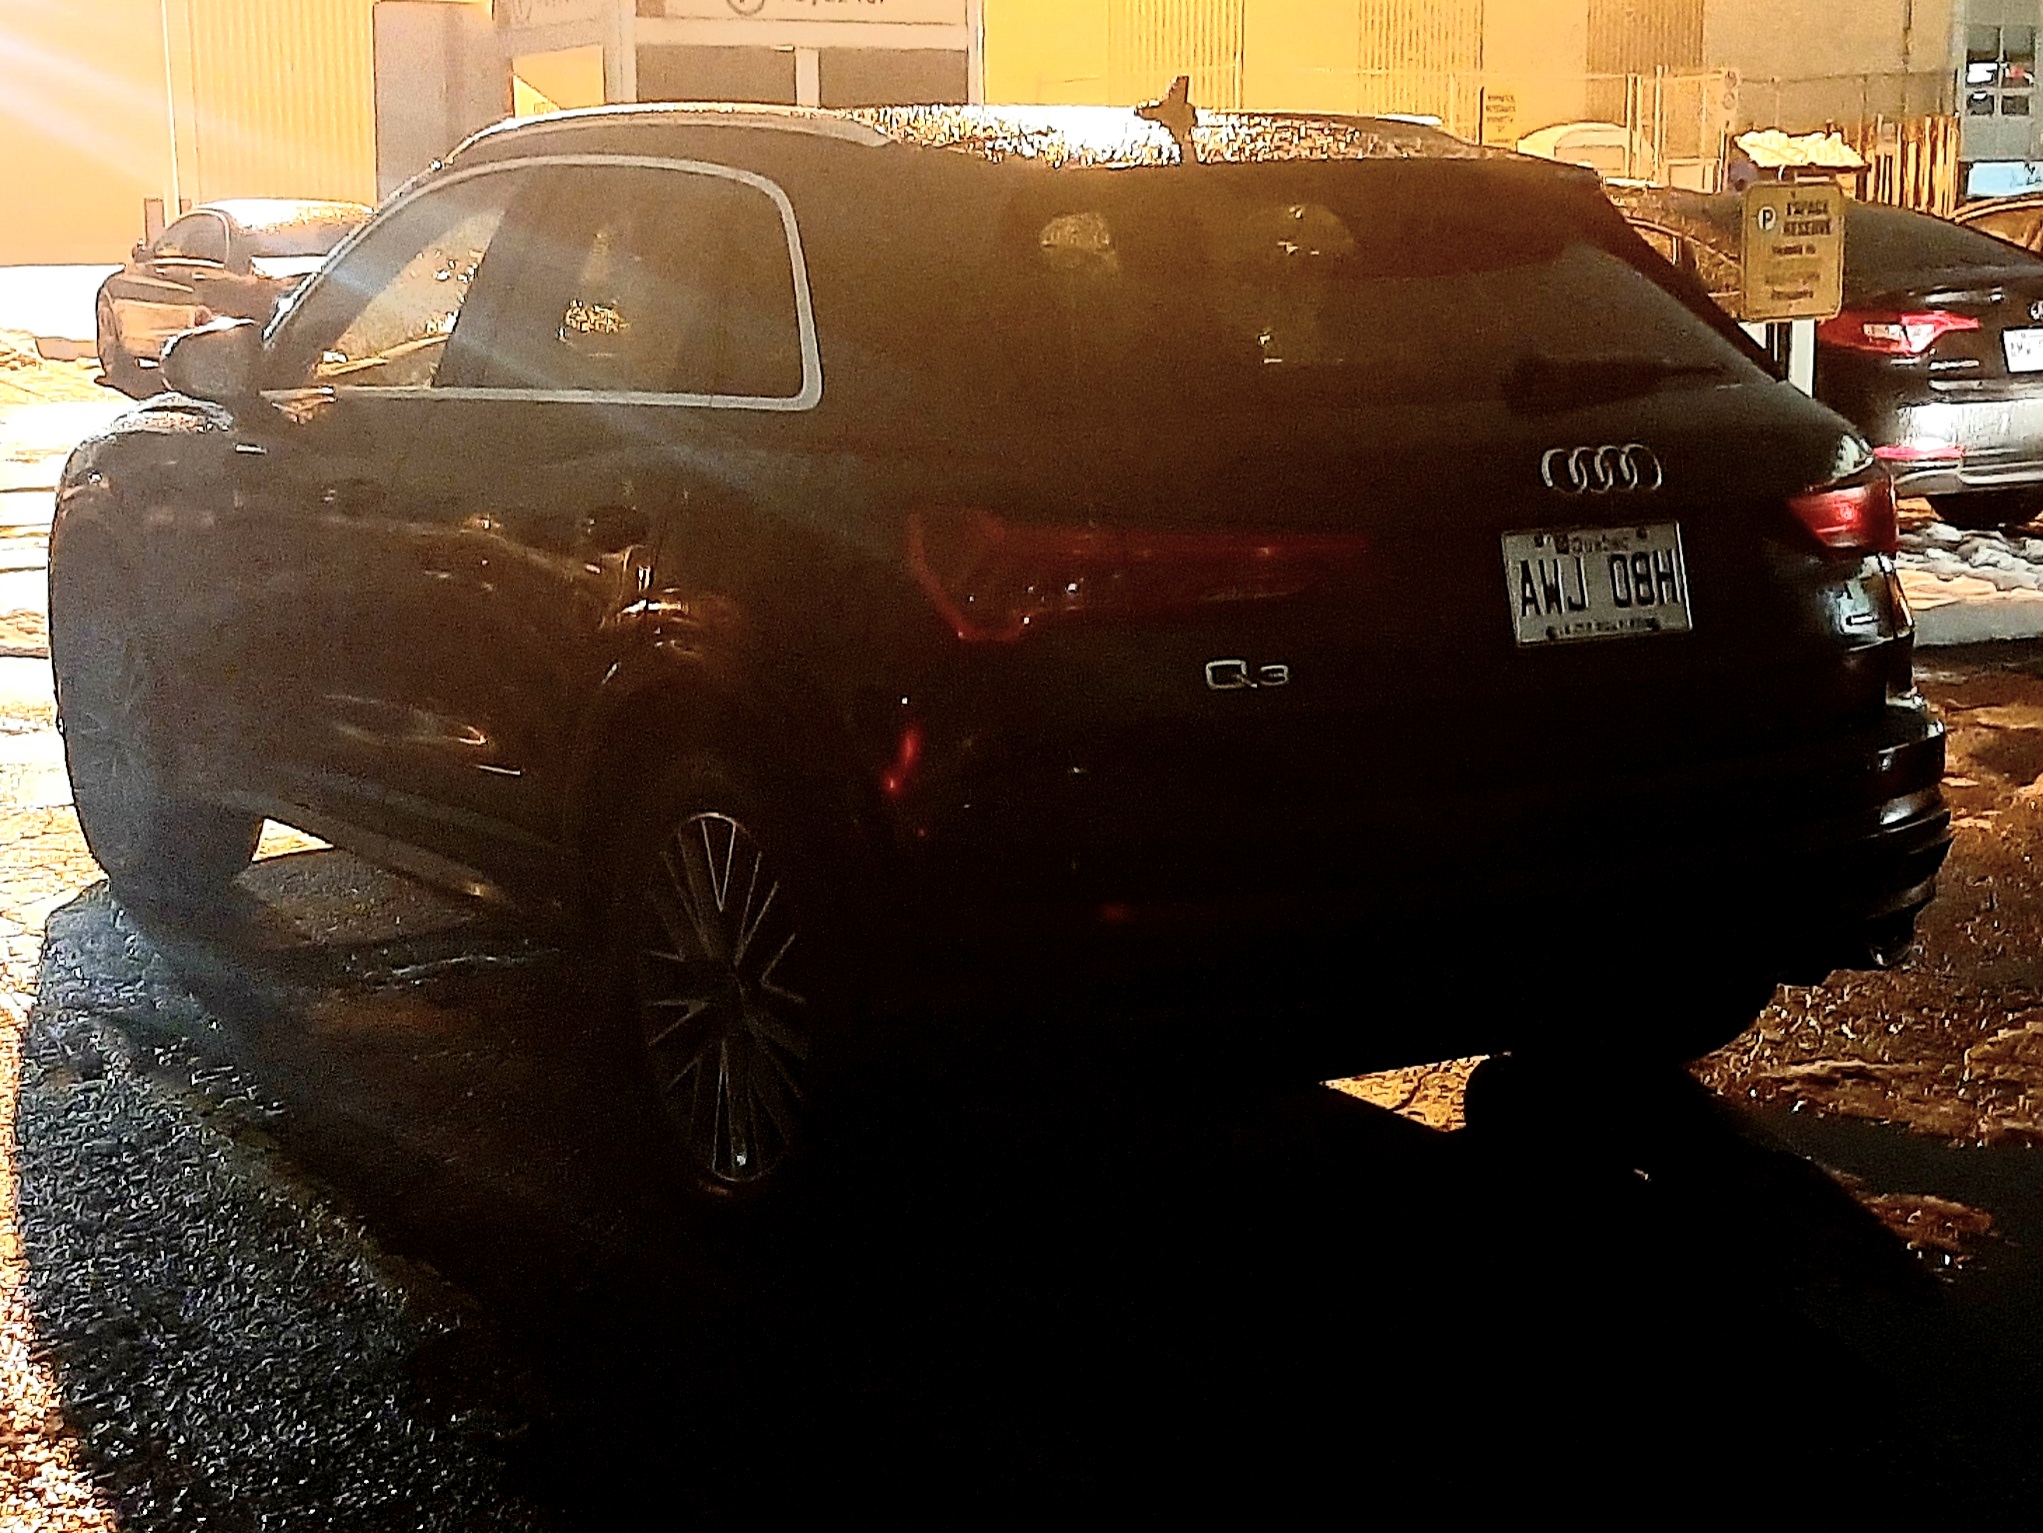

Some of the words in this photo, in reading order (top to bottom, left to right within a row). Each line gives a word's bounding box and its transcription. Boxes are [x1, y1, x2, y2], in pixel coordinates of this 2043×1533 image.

[1520, 555, 1588, 617] AWJ
[1609, 550, 1681, 608] 08H
[1205, 660, 1289, 689] Q3
